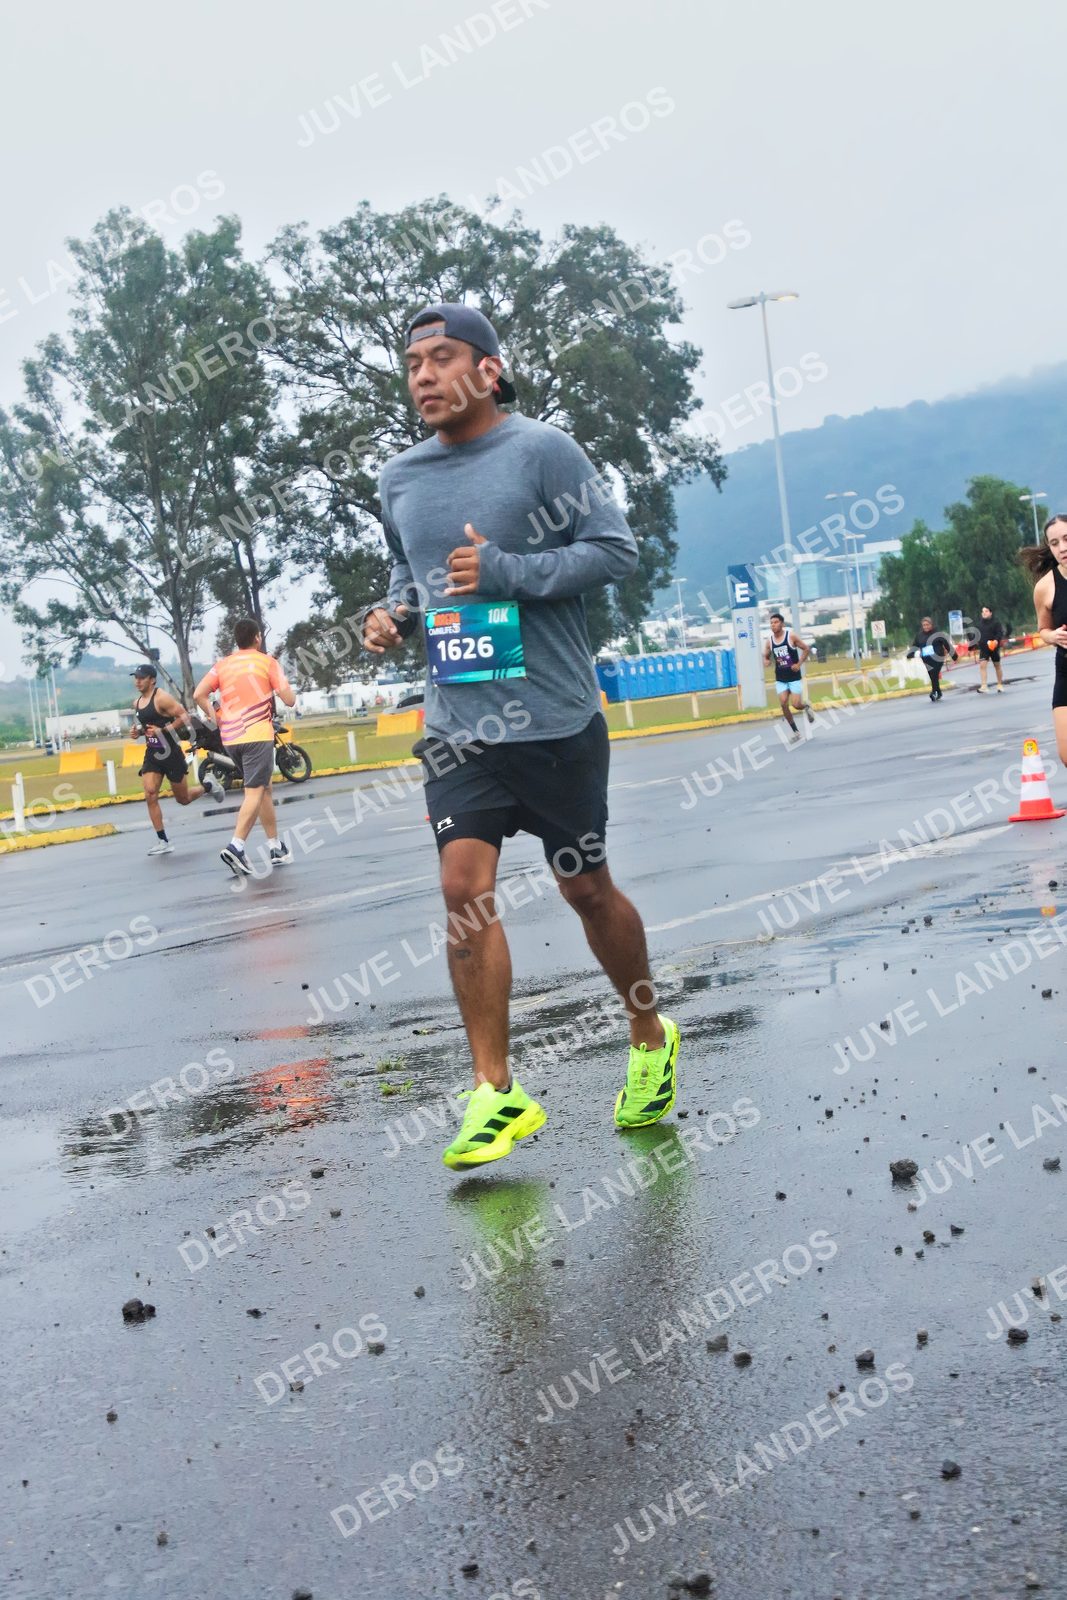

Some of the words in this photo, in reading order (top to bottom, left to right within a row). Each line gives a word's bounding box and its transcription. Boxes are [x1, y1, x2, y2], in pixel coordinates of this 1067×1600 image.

[735, 582, 749, 603] E
[488, 607, 508, 624] 10K
[437, 636, 494, 662] 1626
